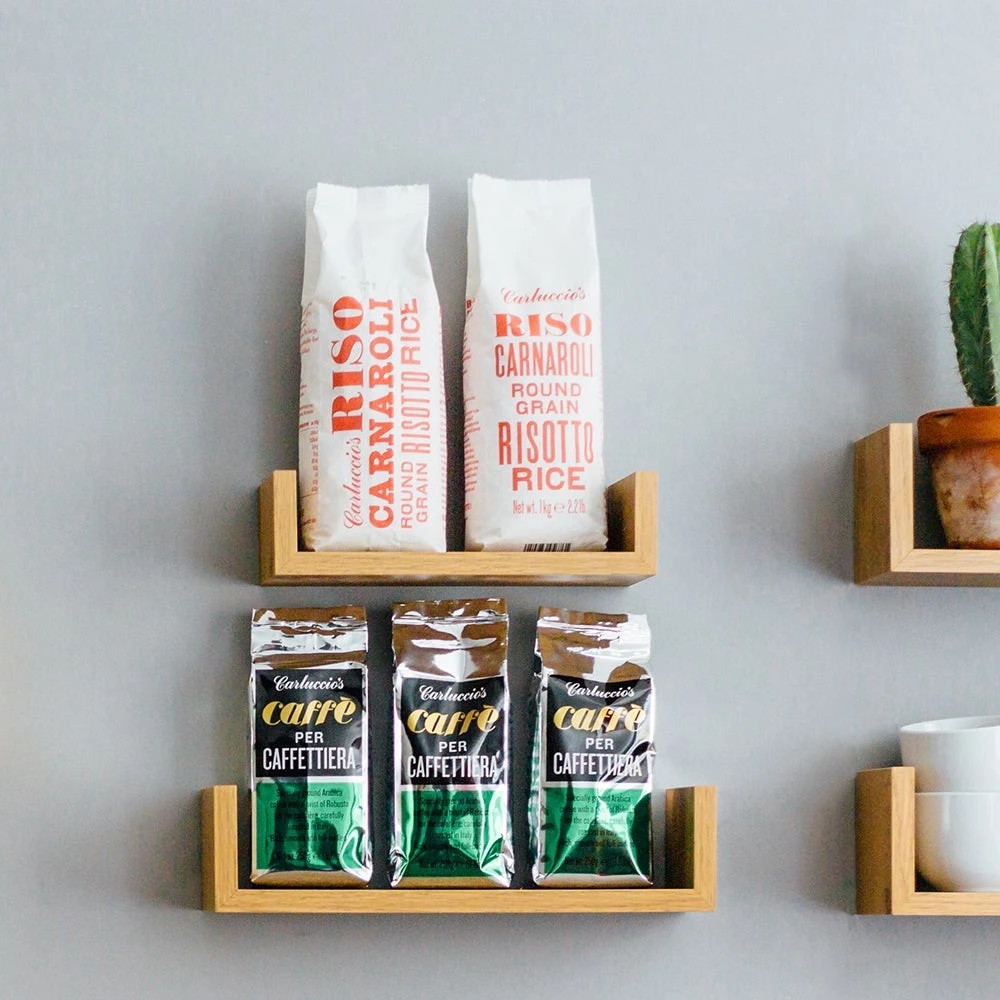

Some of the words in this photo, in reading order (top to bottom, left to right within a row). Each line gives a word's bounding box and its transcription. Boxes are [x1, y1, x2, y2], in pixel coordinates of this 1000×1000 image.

[500, 287, 587, 304] Carluccio's
[400, 297, 422, 365] RICE
[494, 312, 593, 338] RISO
[331, 295, 364, 435] RISO
[494, 341, 594, 379] CARNAROLI
[511, 382, 582, 398] ROUND
[368, 298, 395, 529] CARNAROLI
[401, 371, 431, 455] RISOTTO
[515, 400, 580, 415] GRAIN
[498, 419, 595, 466] RISOTTO
[343, 436, 362, 529] Carluccio's
[512, 466, 586, 491] RICE
[400, 460, 414, 529] ROUND
[415, 462, 428, 524] GRAIN
[273, 674, 345, 691] Carluccio's
[419, 684, 487, 701] Carluccio's
[566, 681, 635, 699] Carluccio's
[261, 696, 356, 726] caffè
[407, 705, 499, 737] caffè
[553, 704, 646, 733] caffè
[295, 731, 324, 744] PER
[439, 741, 467, 753] PER
[586, 738, 614, 750] PER
[263, 747, 356, 770] CAFFETTIERA
[408, 754, 498, 779] CAFFETTIERA
[554, 751, 643, 777] CAFFETTIERA
